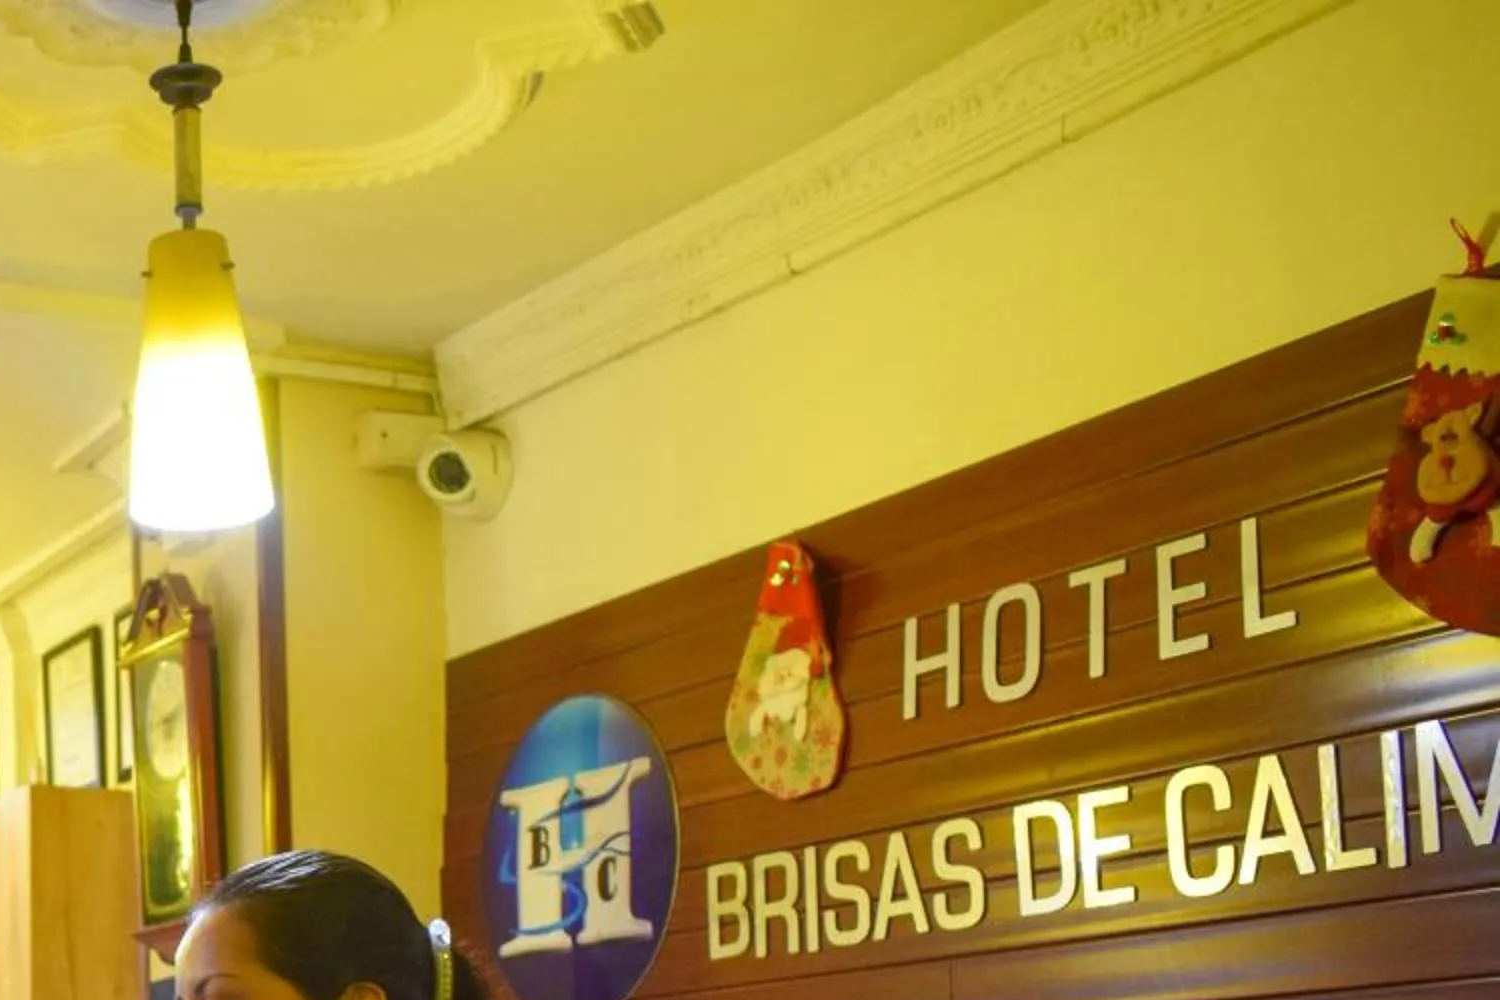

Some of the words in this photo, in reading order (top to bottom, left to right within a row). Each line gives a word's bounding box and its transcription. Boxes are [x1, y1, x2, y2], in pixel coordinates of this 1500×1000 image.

[902, 517, 1297, 720] HOTEL
[707, 818, 986, 961] BRISAS
[1013, 786, 1135, 918] DE
